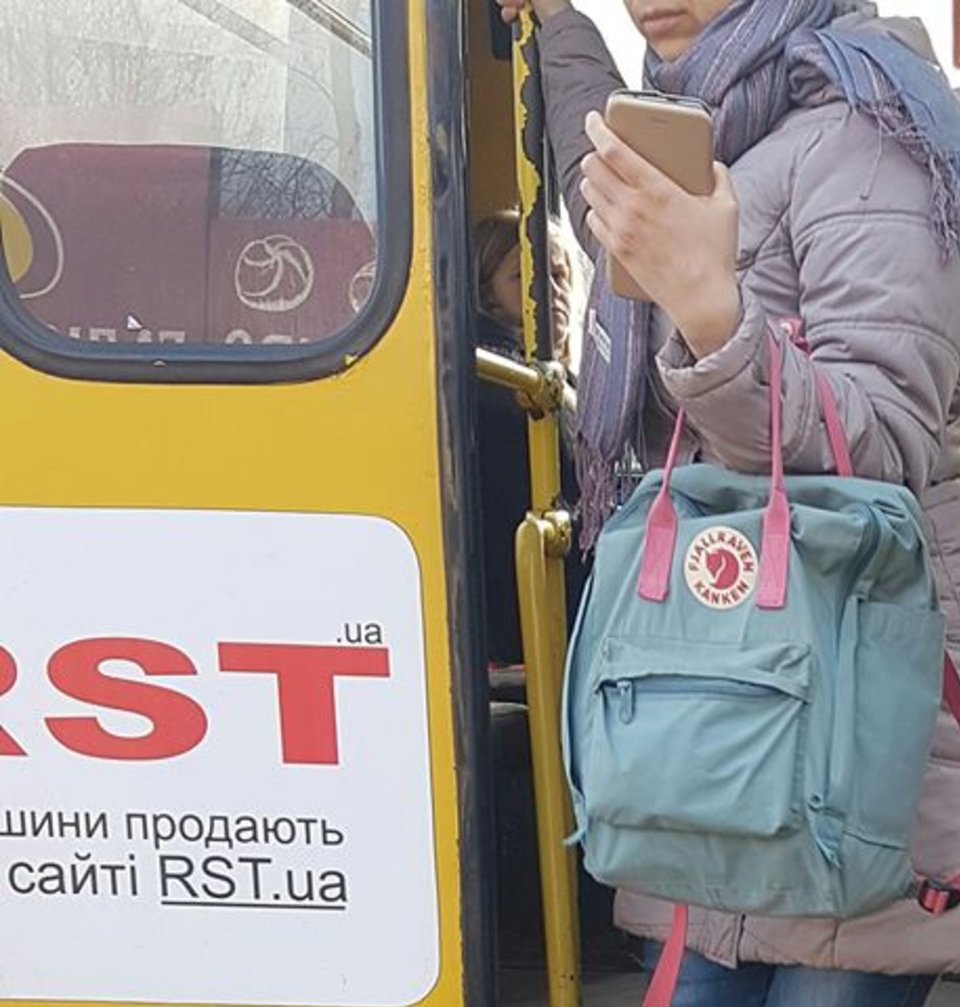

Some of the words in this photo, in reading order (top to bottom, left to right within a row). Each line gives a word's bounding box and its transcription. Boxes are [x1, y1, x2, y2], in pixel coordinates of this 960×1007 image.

[335, 622, 383, 645] .ua
[0, 636, 391, 766] ST
[126, 812, 345, 850] продають
[8, 851, 138, 896] сайті
[159, 854, 348, 903] RST.ua
